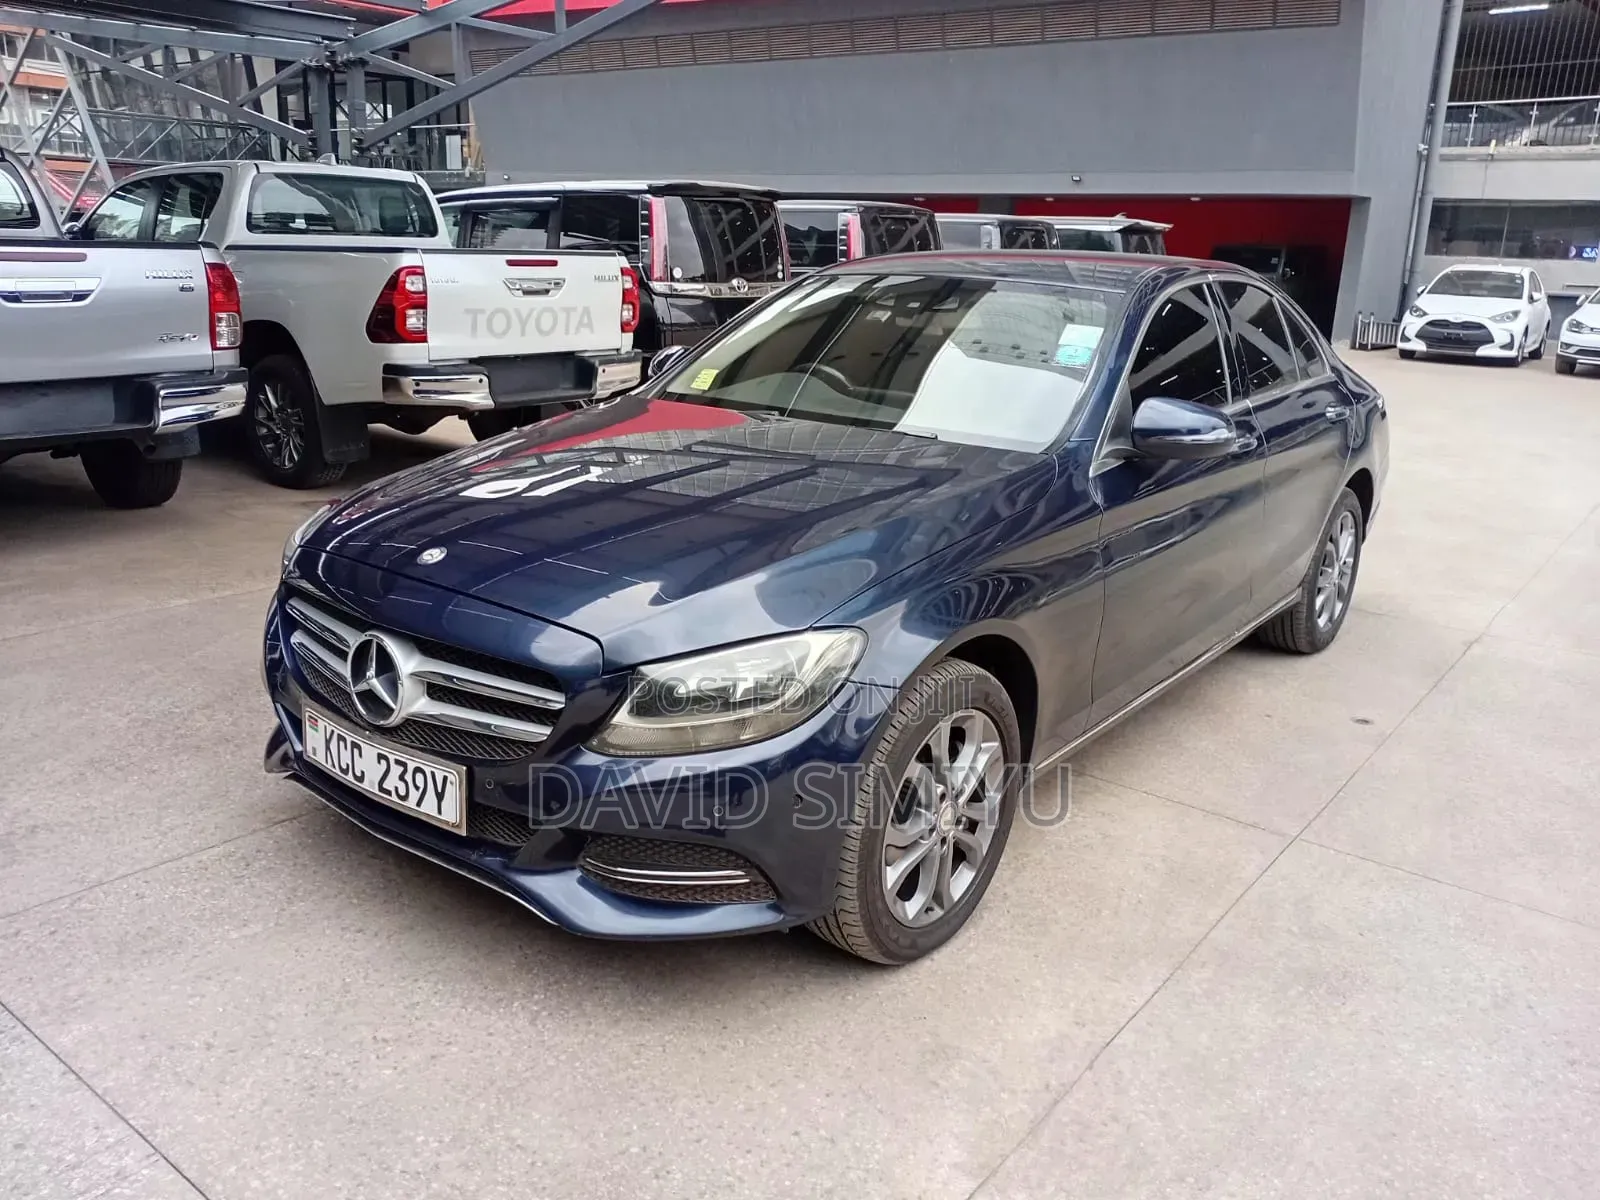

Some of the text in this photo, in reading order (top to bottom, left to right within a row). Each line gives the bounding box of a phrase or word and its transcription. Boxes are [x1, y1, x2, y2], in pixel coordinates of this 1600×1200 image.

[464, 305, 595, 340] TOYOTA
[323, 724, 449, 816] KCC 239Y
